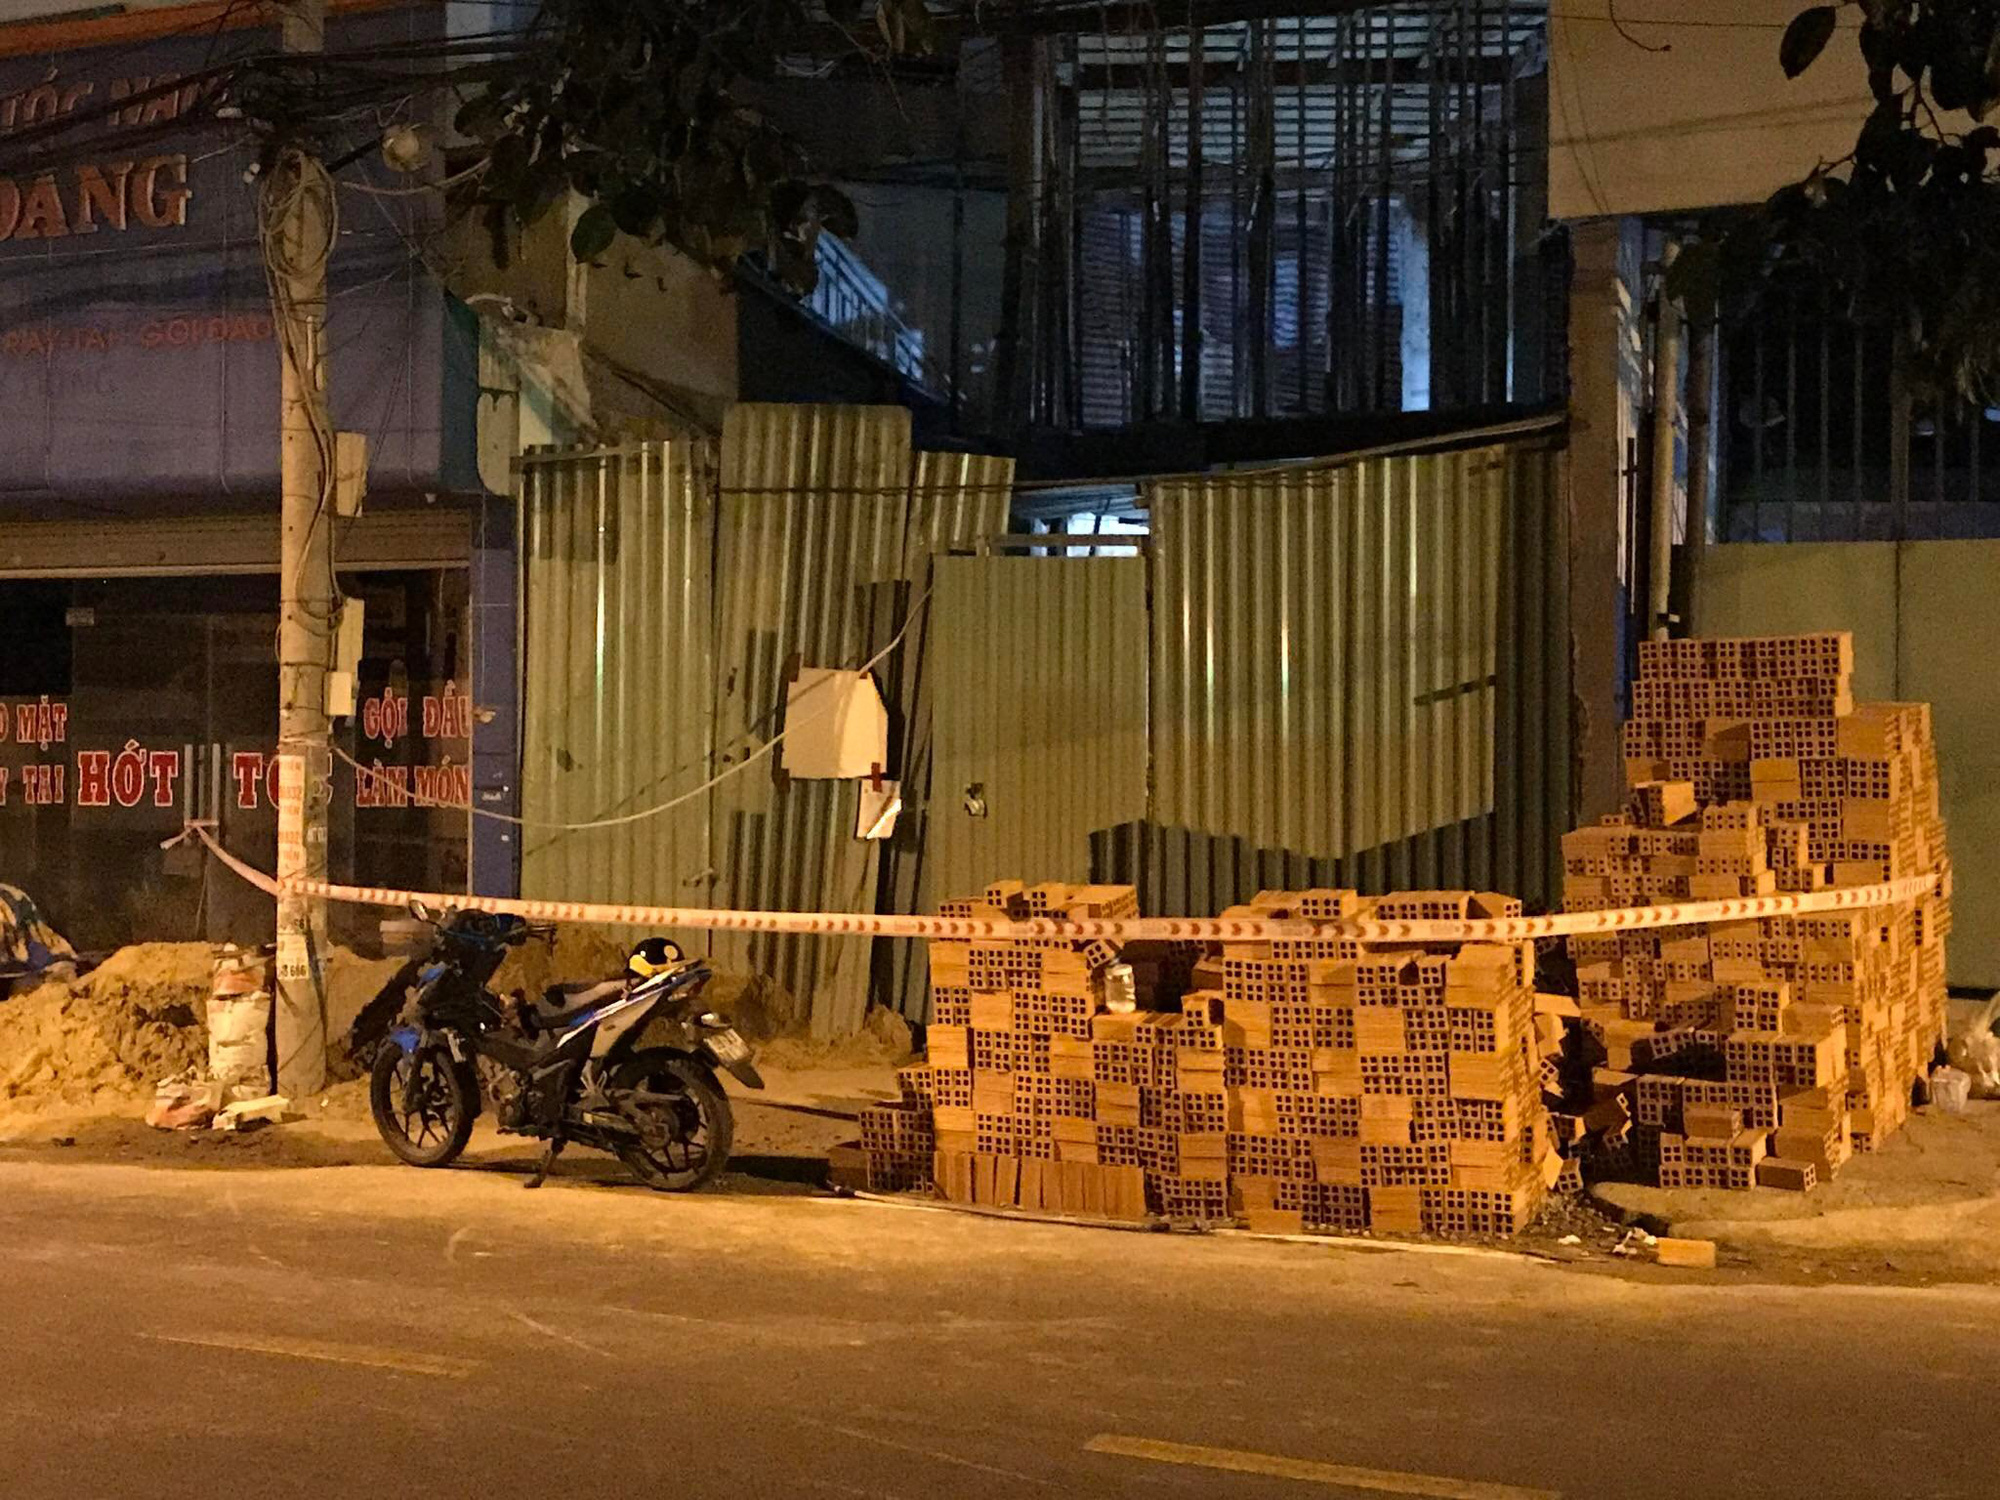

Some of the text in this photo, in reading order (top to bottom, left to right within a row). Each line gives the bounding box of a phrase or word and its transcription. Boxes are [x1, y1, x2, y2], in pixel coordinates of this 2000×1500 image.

[16, 694, 68, 752] MẶT
[363, 686, 408, 749] GỘI
[22, 764, 65, 805] TAI
[77, 739, 179, 808] HỚT
[356, 757, 408, 808] LÀM
[413, 754, 471, 809] MÓN
